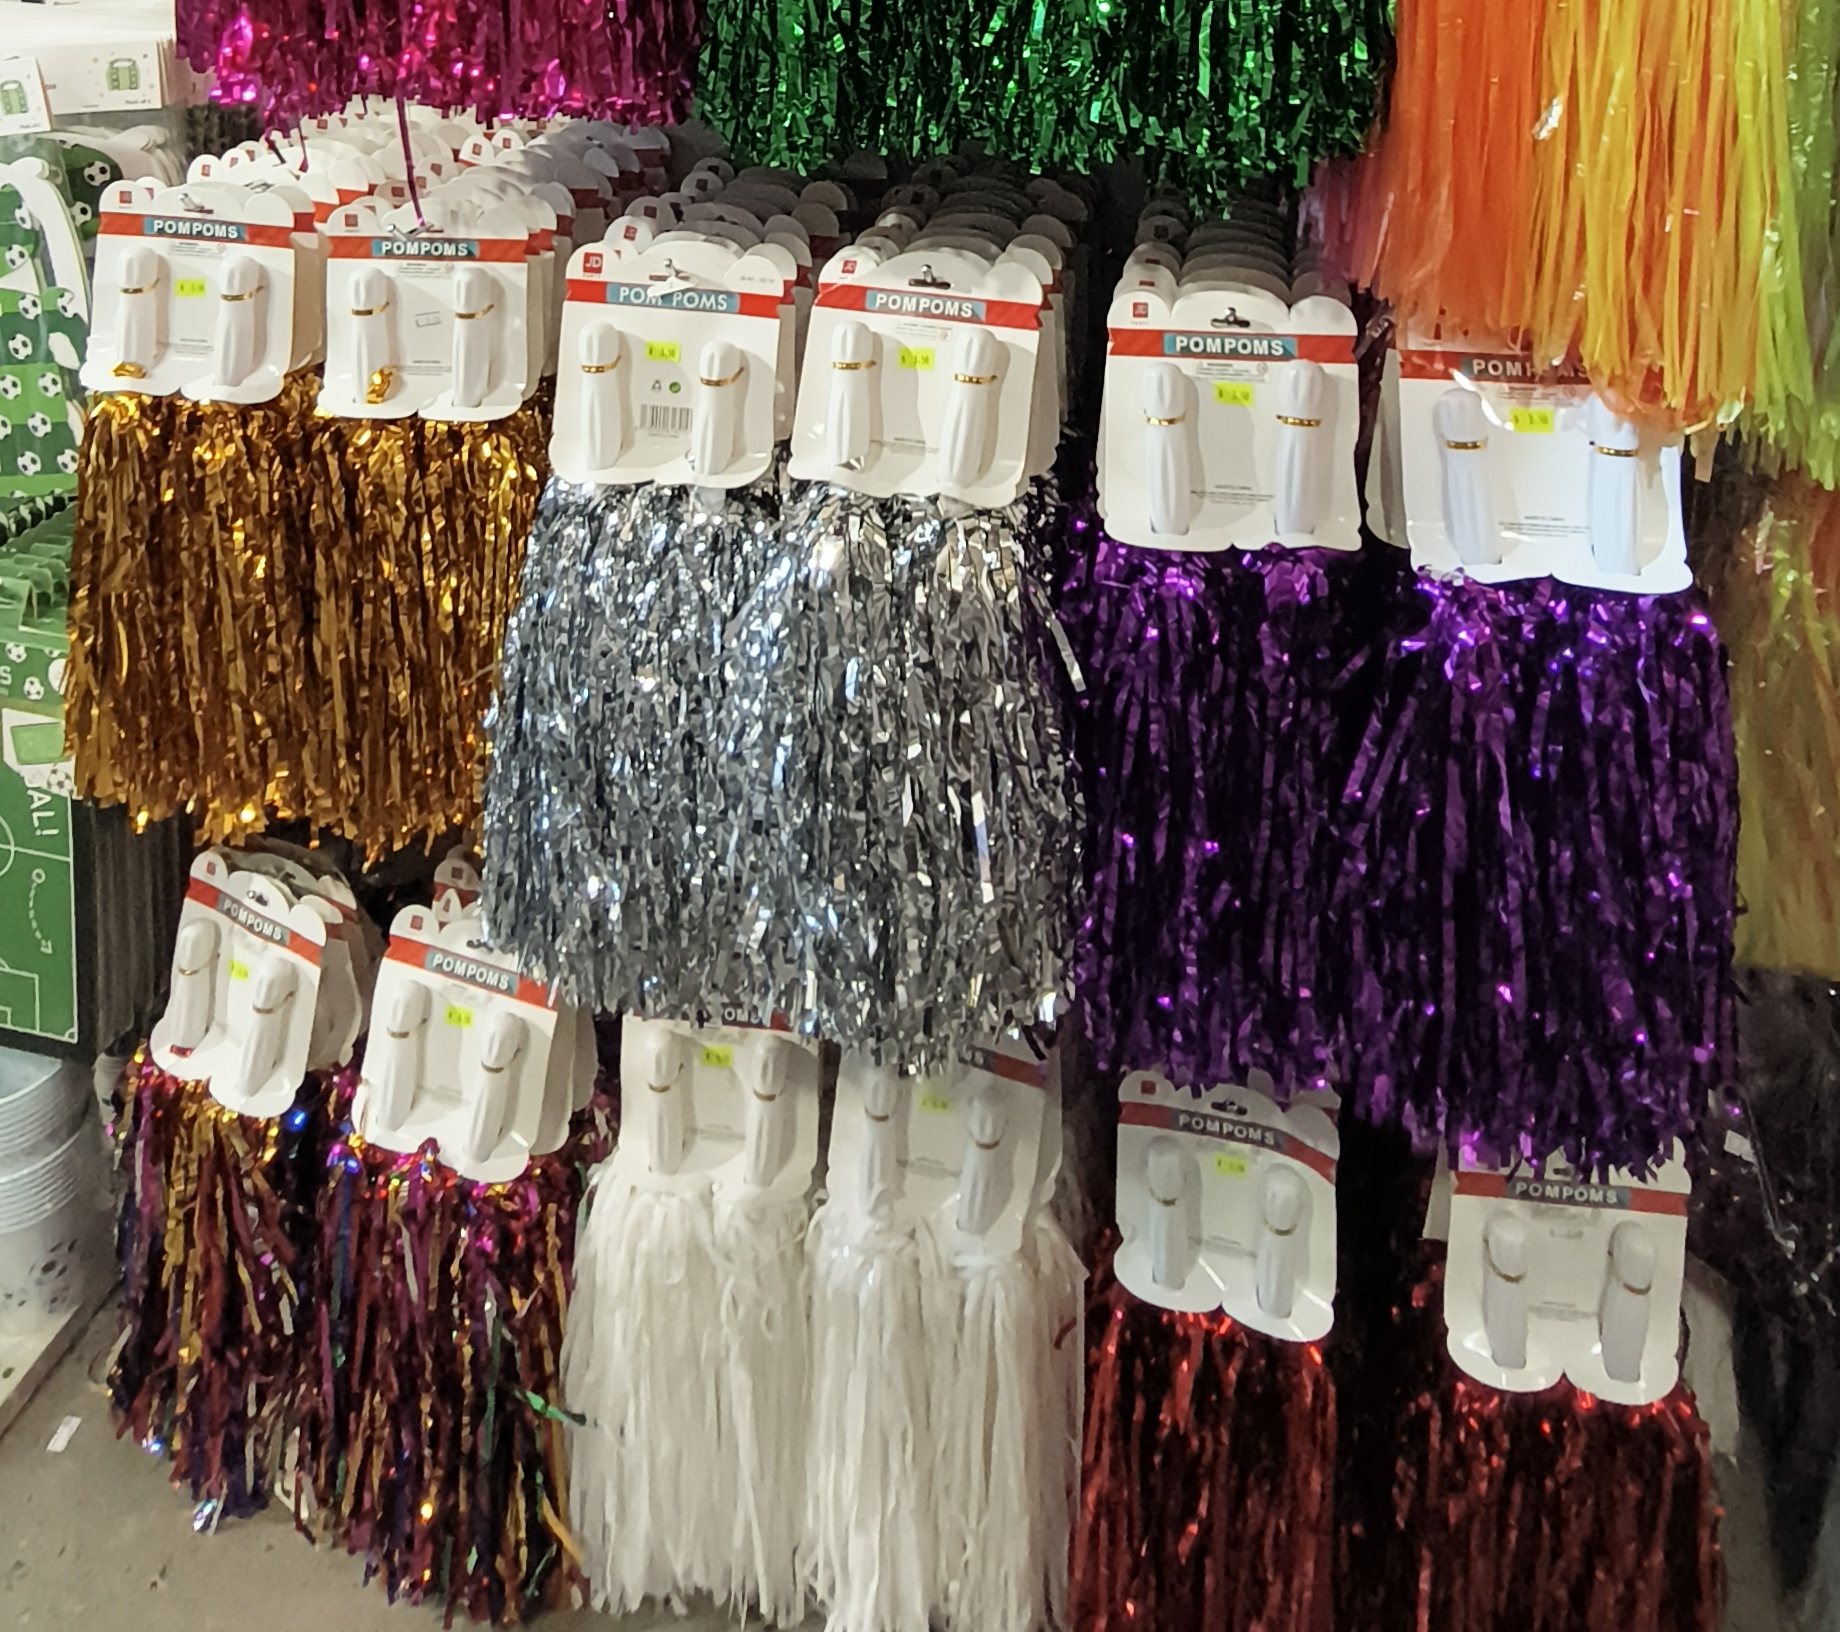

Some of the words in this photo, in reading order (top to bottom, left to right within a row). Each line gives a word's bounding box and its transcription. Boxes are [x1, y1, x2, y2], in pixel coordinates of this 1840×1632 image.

[152, 219, 239, 239] POMPOMS
[381, 241, 469, 257] POMPOMS
[585, 256, 602, 268] JD
[619, 286, 663, 306] POM
[672, 291, 728, 311] POMS
[875, 294, 974, 318] POMPOMS
[1175, 335, 1285, 356] POMPOMS
[223, 898, 283, 941] POMPOMS
[432, 953, 511, 991] POMPOMS
[1178, 1113, 1276, 1146] POMPOMS
[1515, 1181, 1619, 1204] POMPOMS
